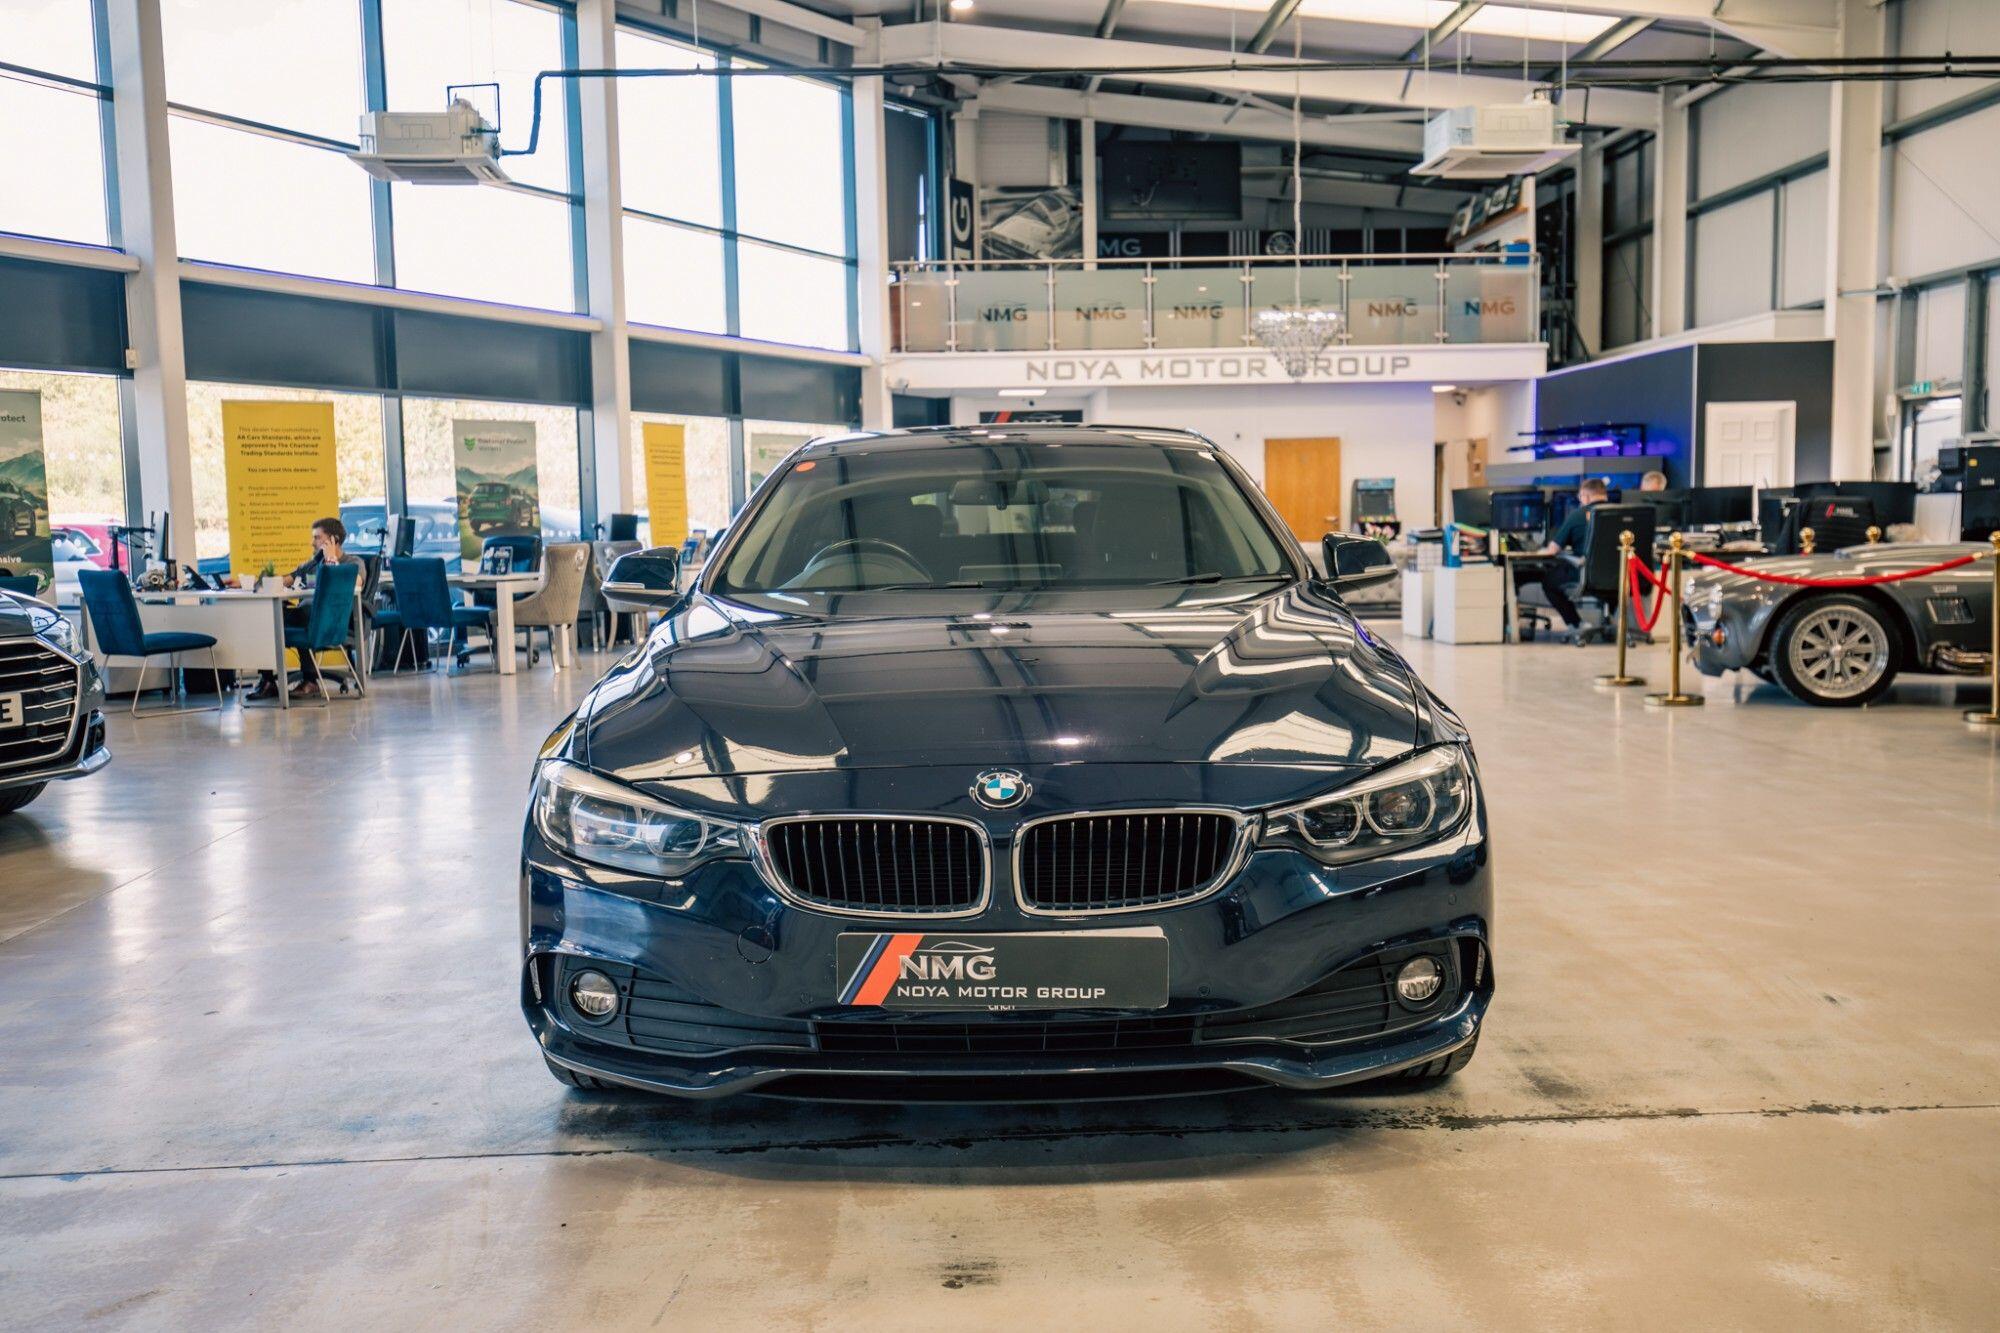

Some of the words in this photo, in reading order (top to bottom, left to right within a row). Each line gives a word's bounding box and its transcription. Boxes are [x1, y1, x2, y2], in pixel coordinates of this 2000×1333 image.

[1098, 238, 1141, 256] MG
[977, 307, 1028, 322] NMG
[1075, 306, 1127, 320] NMG
[1173, 304, 1225, 319] NMG
[1368, 302, 1418, 316] NMG
[1464, 300, 1516, 315] NMG
[1026, 360, 1122, 380] NOYA
[1140, 358, 1267, 379] MOTOR
[0, 414, 26, 422] otect
[899, 954, 997, 980] NMG
[897, 986, 950, 998] NOYA
[958, 986, 1028, 998] MOTOR
[1037, 987, 1106, 999] GROUP
